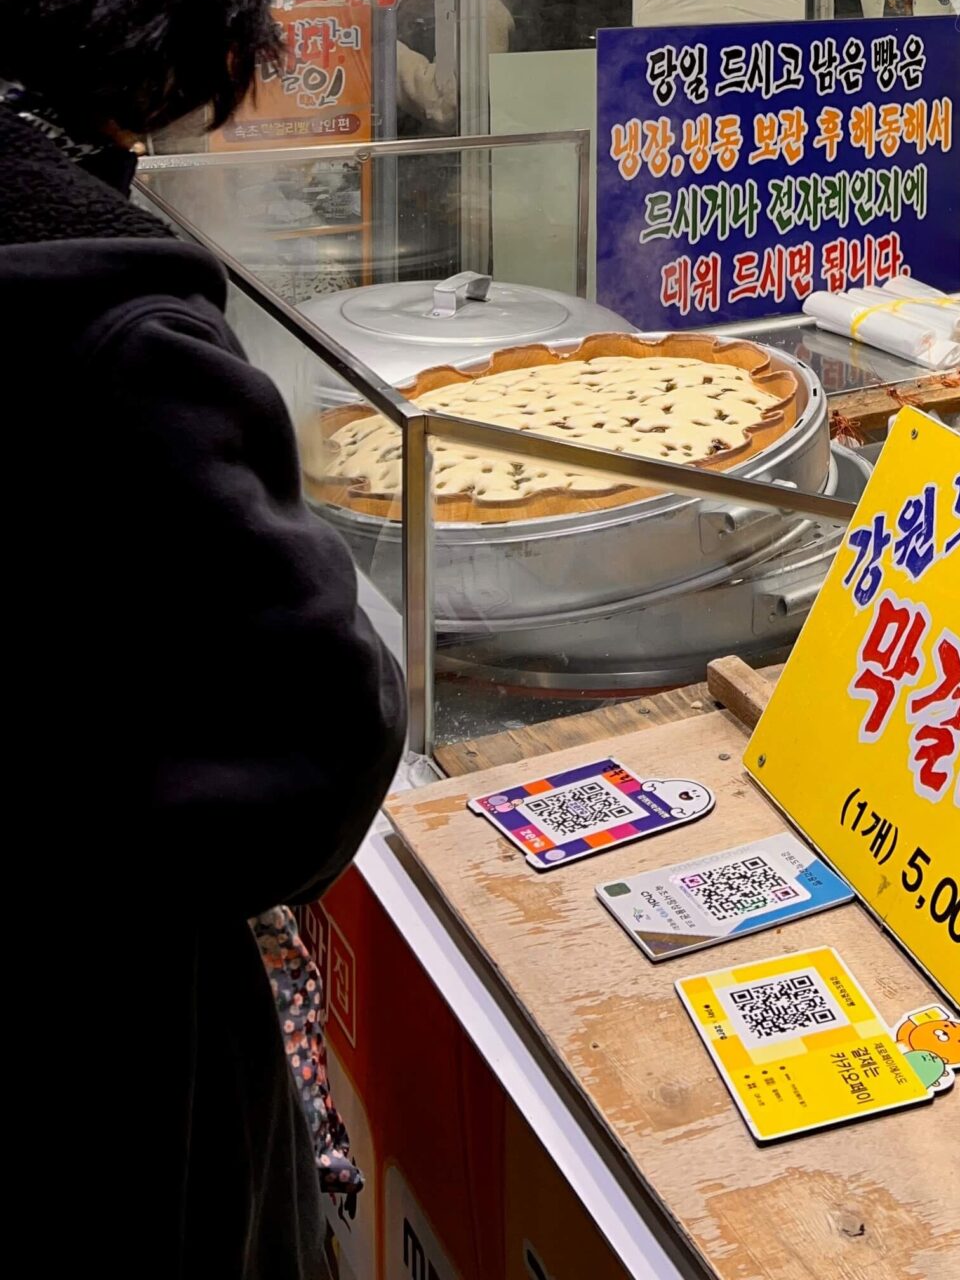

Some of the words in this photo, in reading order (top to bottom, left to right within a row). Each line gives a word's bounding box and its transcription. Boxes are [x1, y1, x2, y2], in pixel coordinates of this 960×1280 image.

[647, 44, 707, 106] 당일
[715, 41, 804, 98] 드시고
[809, 38, 866, 96] 남은
[871, 34, 926, 90] 빵은
[610, 113, 742, 180] 냉장,냉동
[749, 108, 807, 164] 보관
[814, 107, 842, 161] 후
[851, 97, 952, 158] 해동해서
[640, 180, 760, 243] 드시거나
[768, 163, 927, 235] 전자레인지에
[661, 253, 720, 315] 데워
[728, 241, 814, 303] 드시면
[821, 231, 911, 293] 됩니다.
[520, 828, 546, 848] zero
[840, 788, 899, 867] (1개)
[639, 890, 662, 908] chak
[712, 1023, 730, 1040] zero
[828, 1048, 875, 1107] 카카오페이
[849, 1044, 883, 1079] 결제는
[871, 1040, 908, 1085] 제로페이에서도
